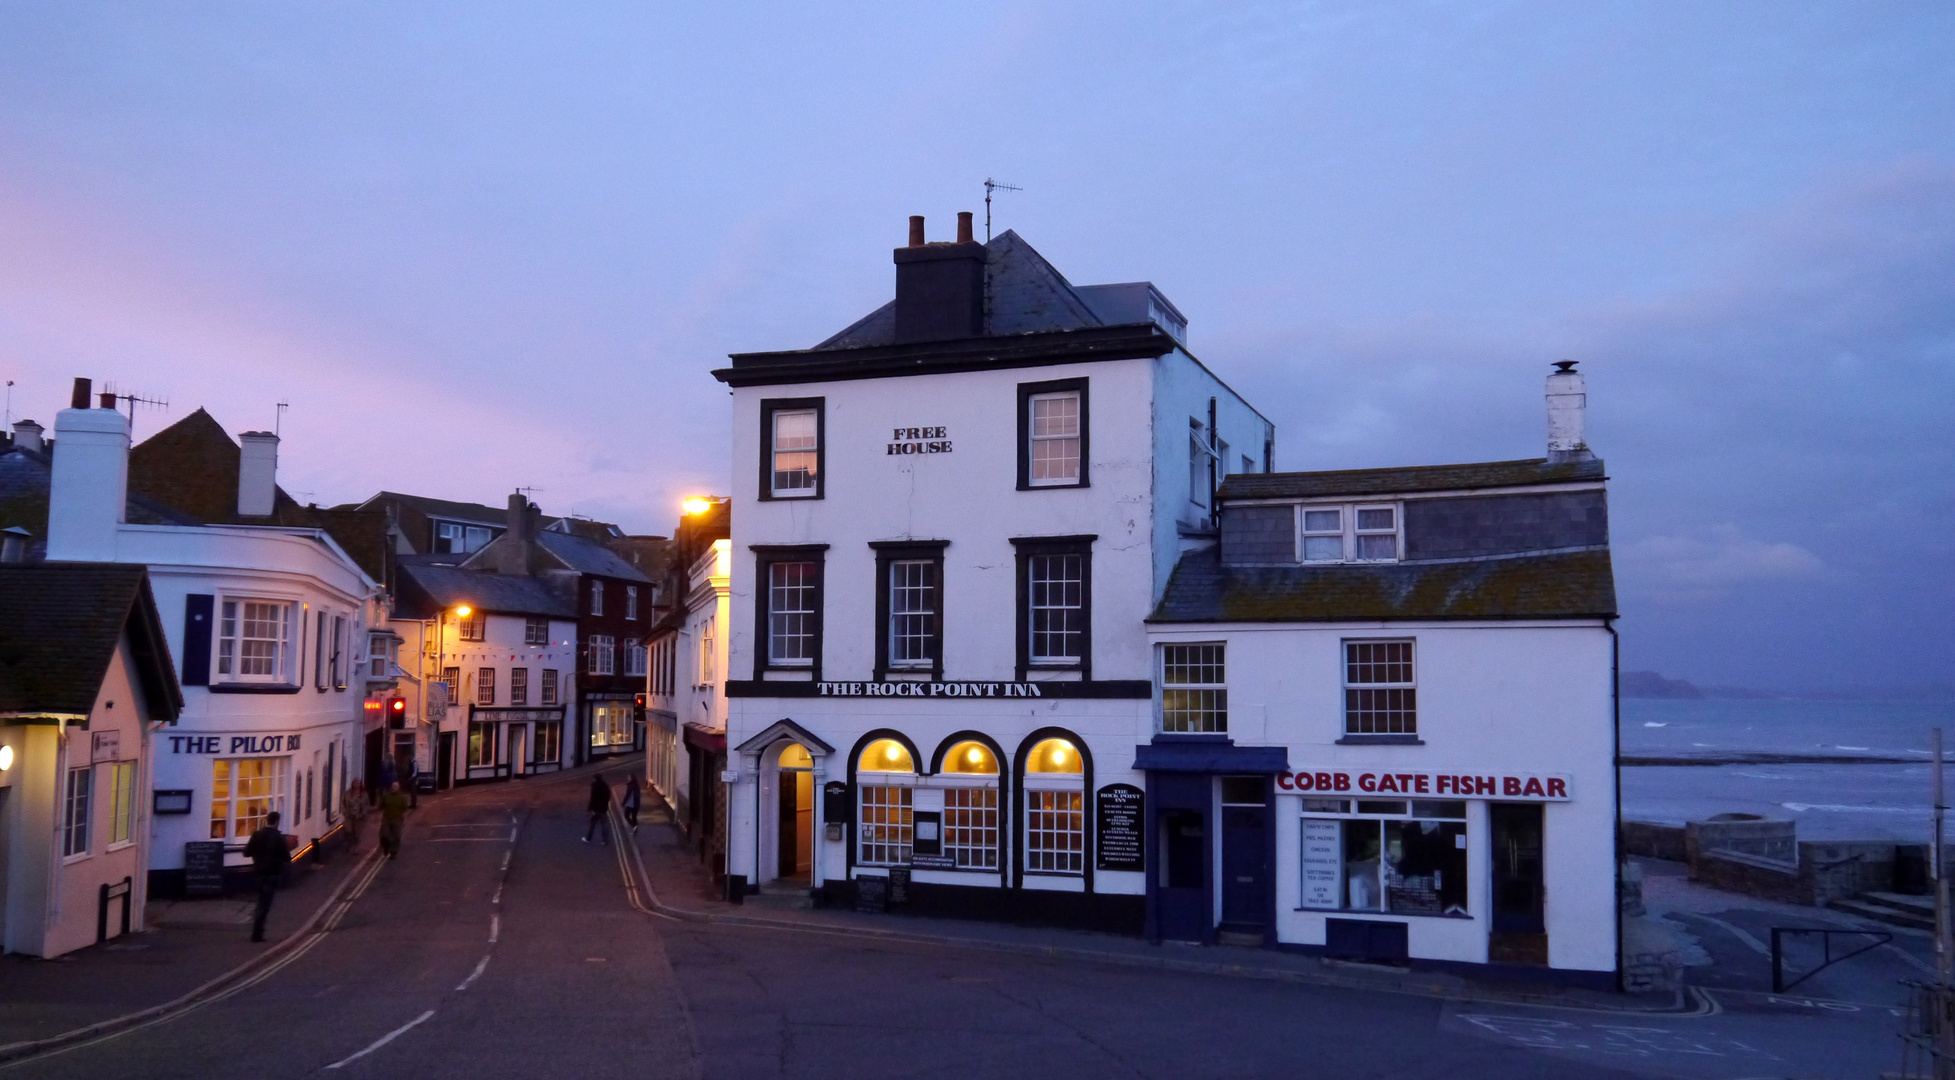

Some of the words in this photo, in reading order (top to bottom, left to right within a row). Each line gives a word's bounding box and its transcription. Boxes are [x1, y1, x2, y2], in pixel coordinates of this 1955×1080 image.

[893, 426, 947, 440] FREE
[886, 441, 953, 455] HOUSE
[817, 682, 861, 696] THE
[865, 682, 925, 696] ROCK
[930, 683, 998, 697] POINT
[1003, 683, 1041, 697] INN
[427, 700, 446, 709] BLUE
[427, 708, 446, 717] LIAS
[168, 736, 221, 754] THE
[230, 735, 284, 754] PILOT
[286, 734, 301, 750] BOX
[1276, 771, 1351, 792] COBB
[1358, 773, 1430, 794] GATE
[1436, 774, 1496, 796] FISH
[1503, 776, 1568, 798] BAR
